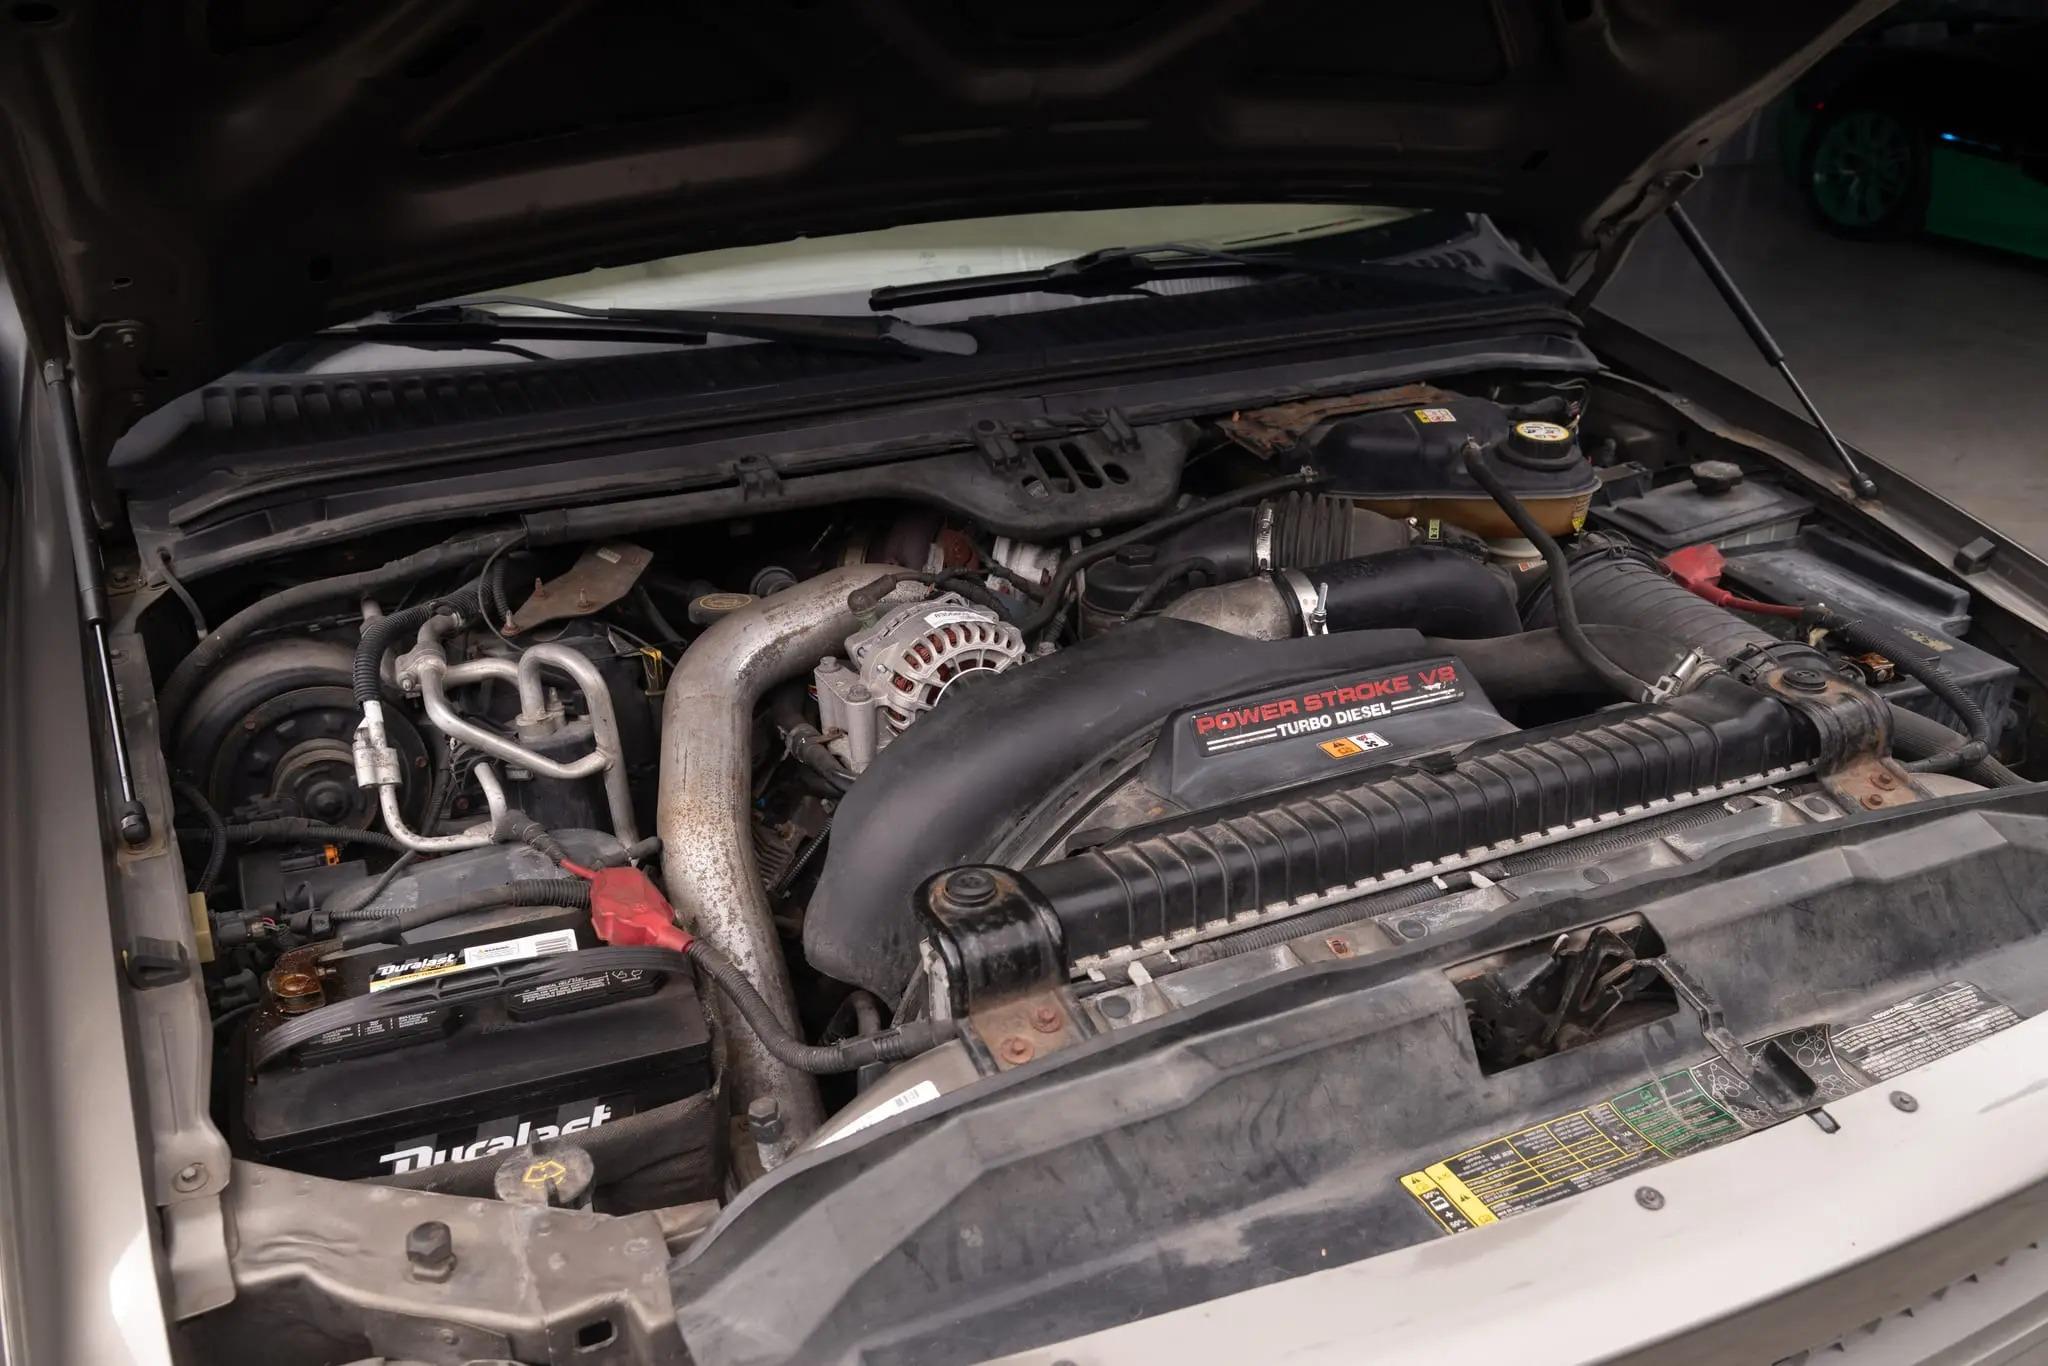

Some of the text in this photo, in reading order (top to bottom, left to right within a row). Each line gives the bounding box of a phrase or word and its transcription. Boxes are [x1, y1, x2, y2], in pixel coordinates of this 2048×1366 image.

[1196, 665, 1457, 735] POWER STROKE V8
[1277, 702, 1392, 737] TURBO DIESEL
[379, 953, 456, 976] Duralast
